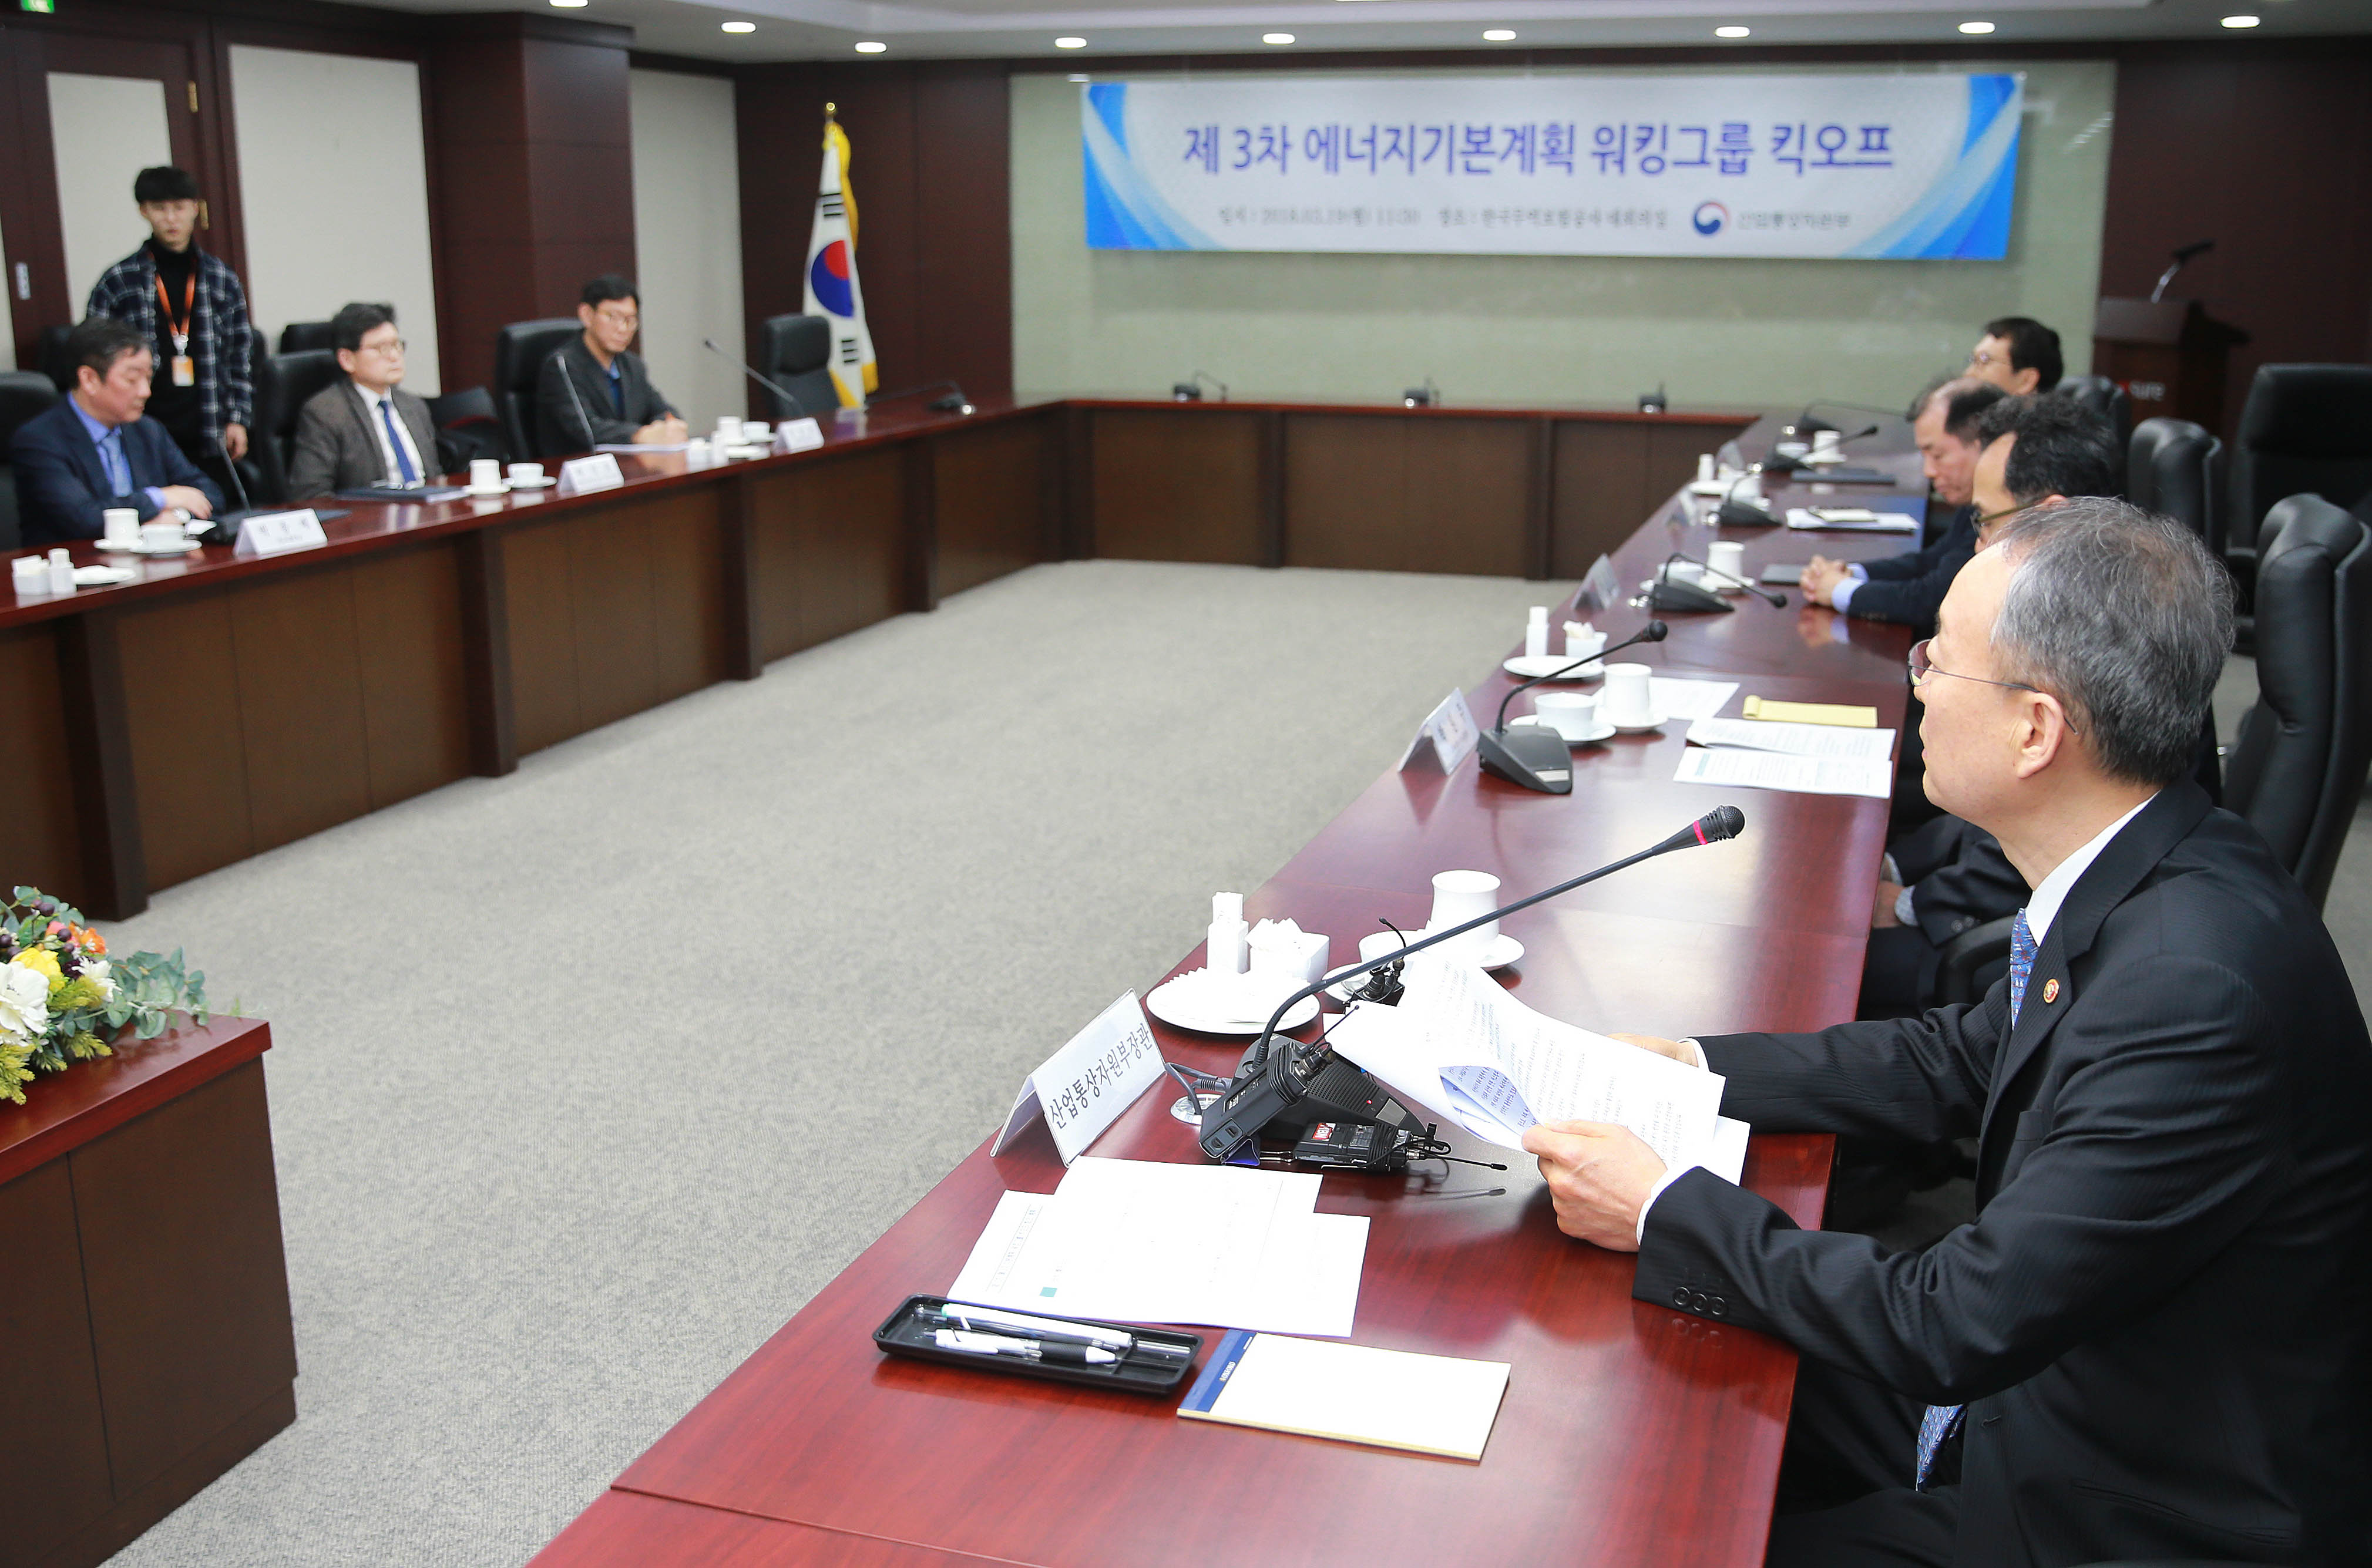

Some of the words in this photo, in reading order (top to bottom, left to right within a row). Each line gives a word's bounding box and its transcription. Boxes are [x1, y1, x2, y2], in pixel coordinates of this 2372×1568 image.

[1184, 125, 1219, 174] 제
[1232, 125, 1292, 174] 3차
[1305, 125, 1575, 175] 에너지기본계획
[1591, 125, 1755, 175] 워킹그룹
[1771, 124, 1893, 176] 킥오프
[1049, 1022, 1153, 1130] 산업통상자원부장관
